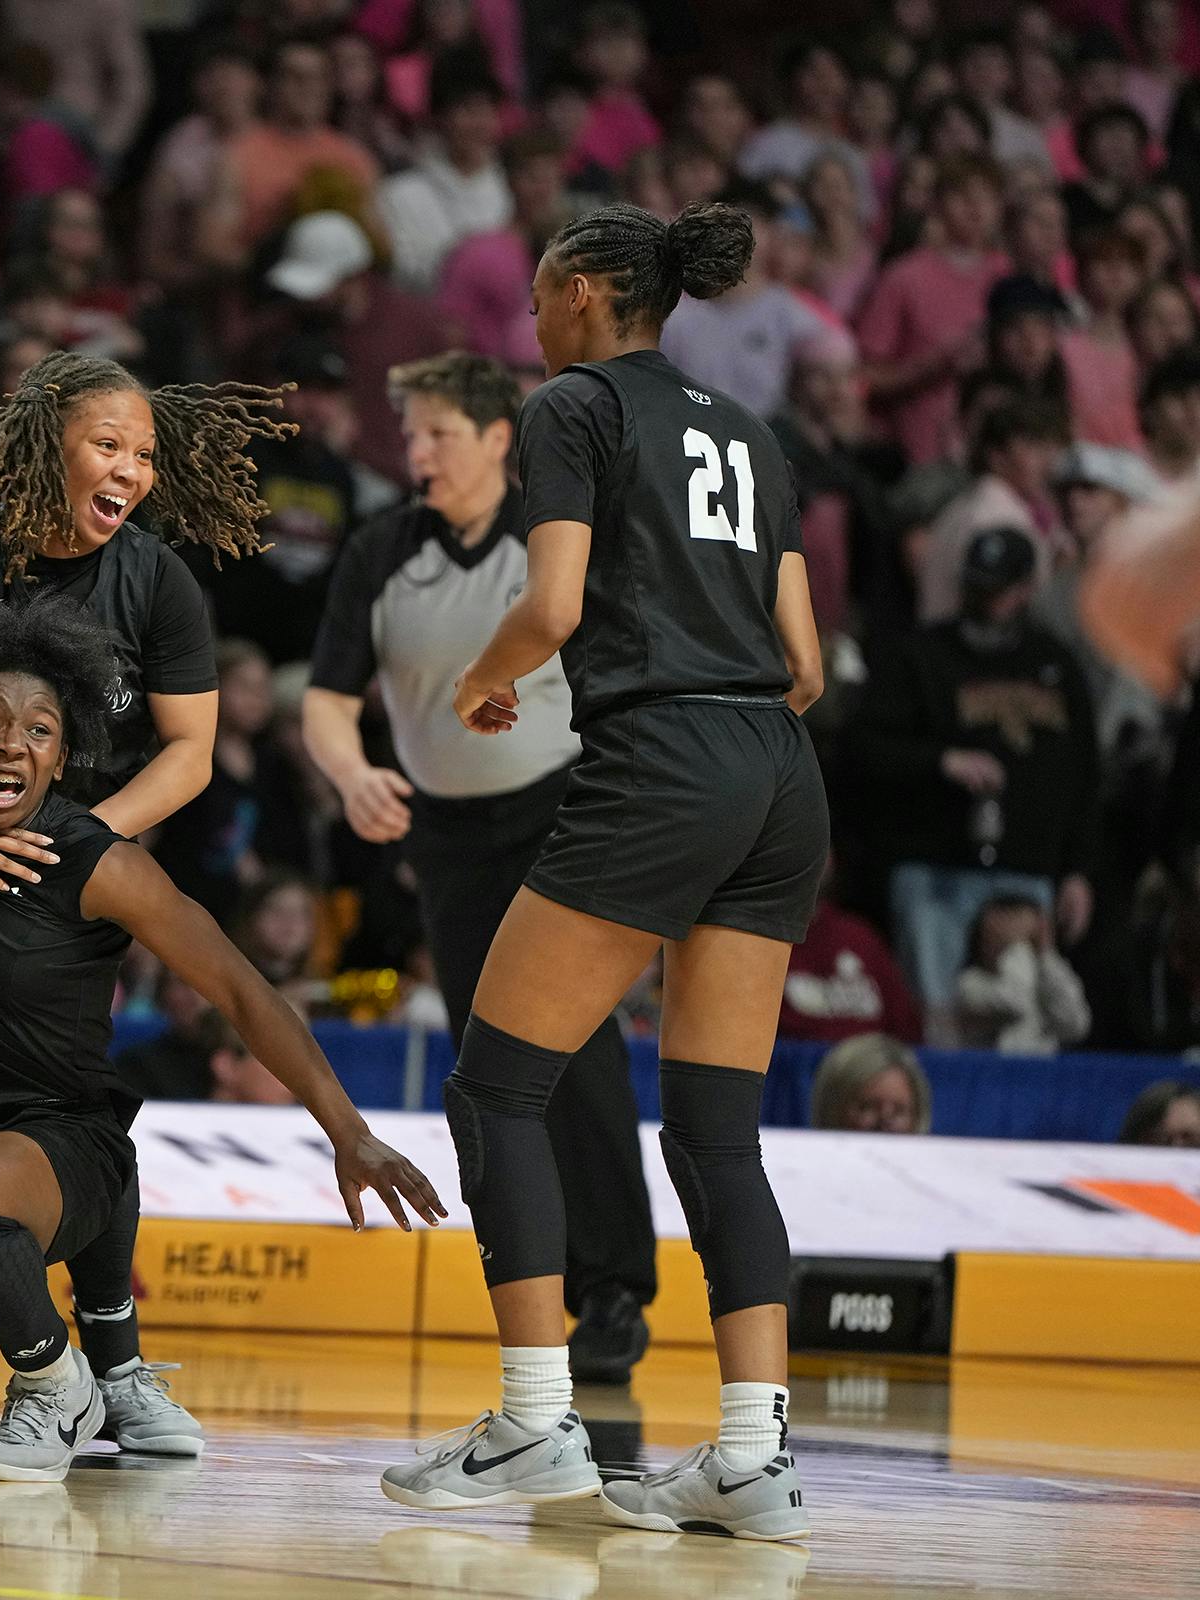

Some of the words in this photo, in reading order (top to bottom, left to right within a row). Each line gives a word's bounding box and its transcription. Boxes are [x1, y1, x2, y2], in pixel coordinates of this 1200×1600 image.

[682, 427, 757, 553] 21
[164, 1242, 310, 1279] HEALTH
[829, 1292, 893, 1332] POSS
